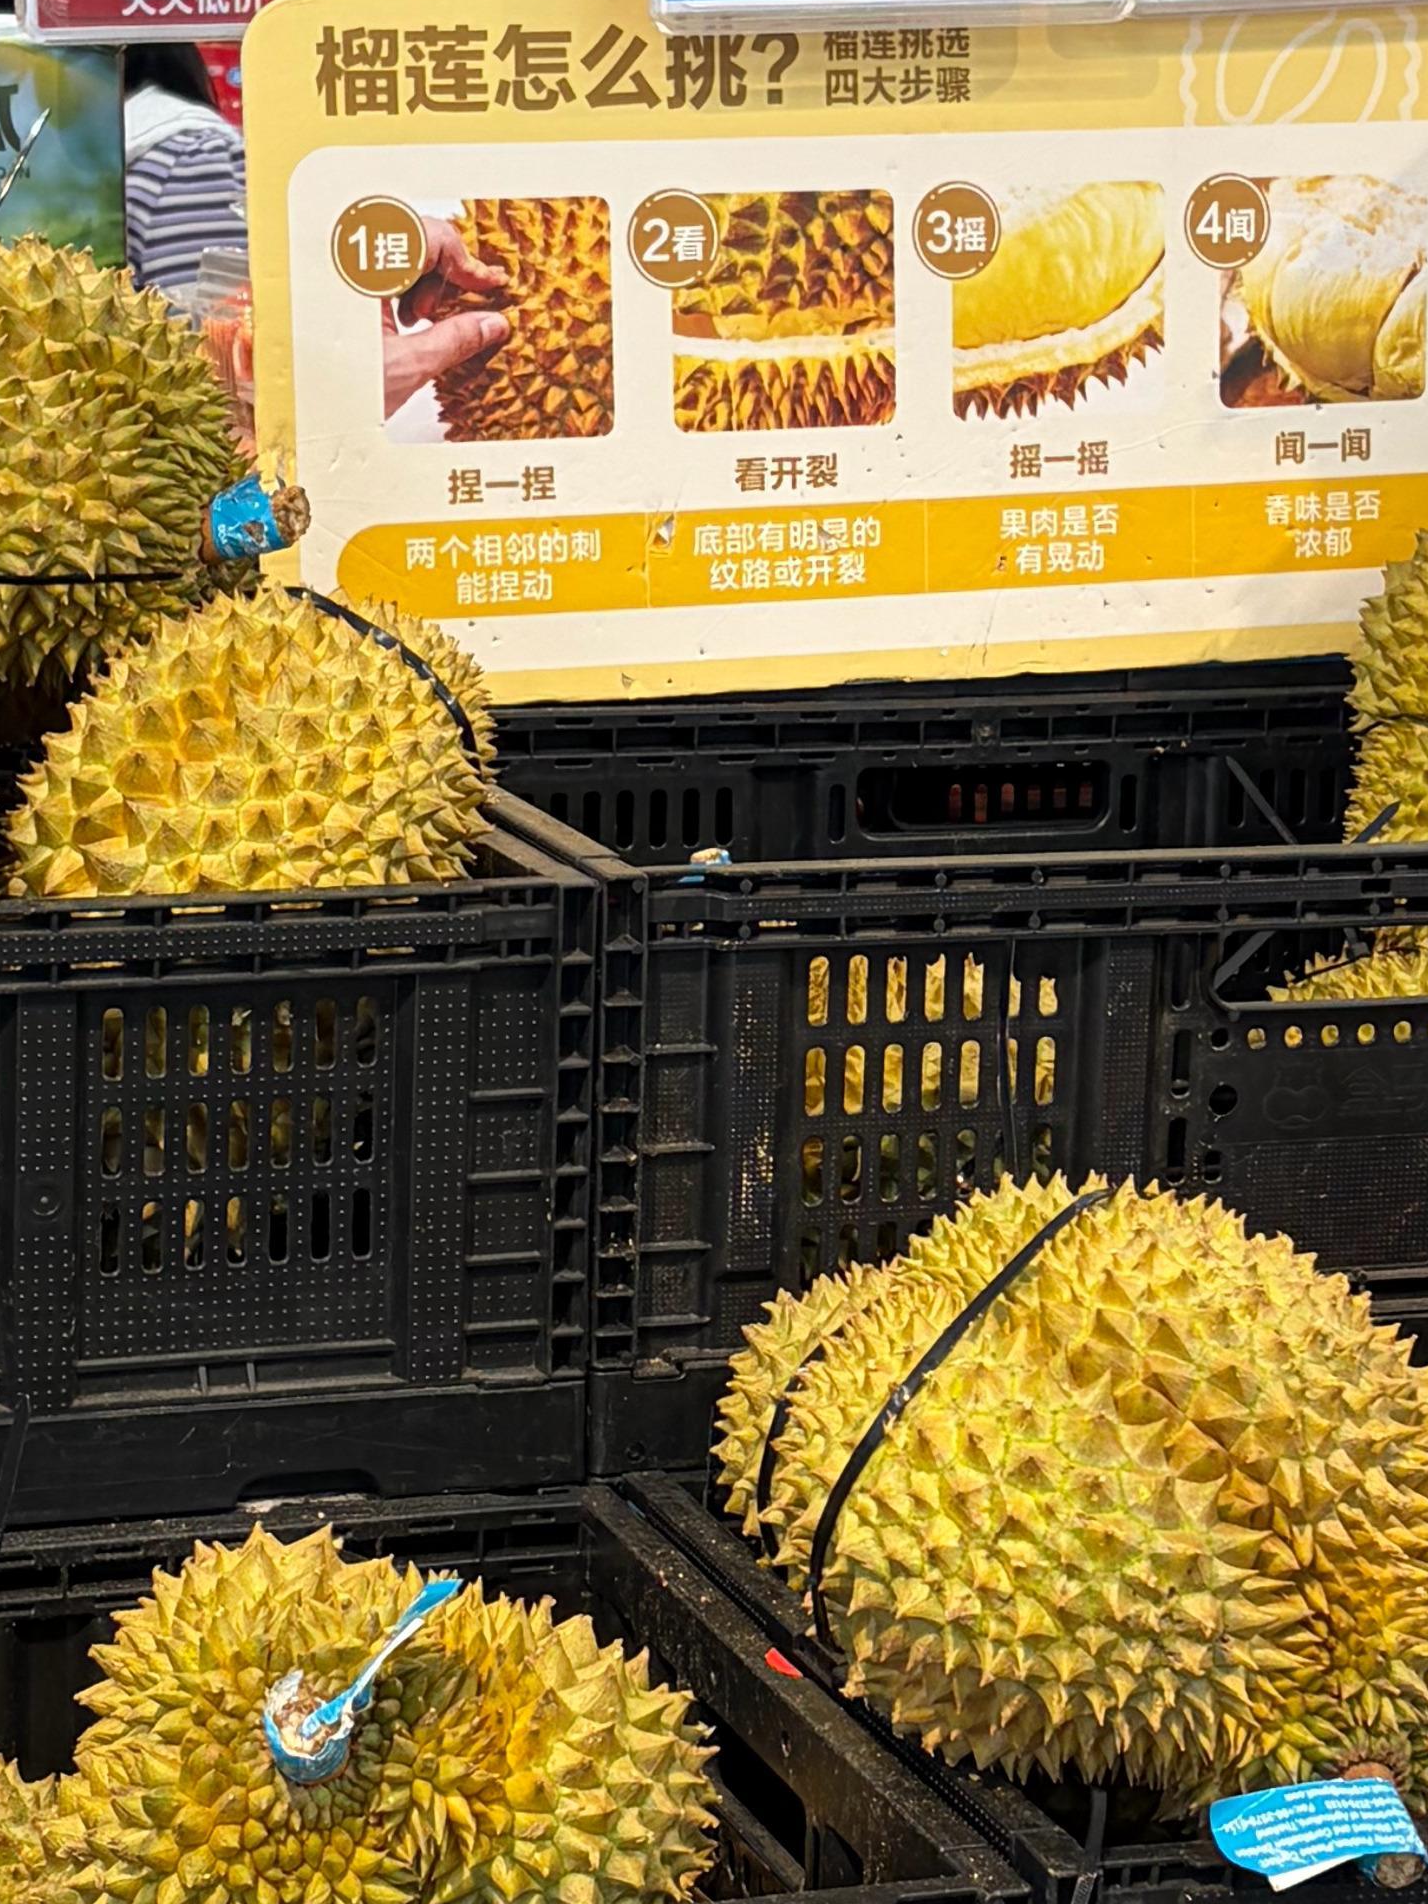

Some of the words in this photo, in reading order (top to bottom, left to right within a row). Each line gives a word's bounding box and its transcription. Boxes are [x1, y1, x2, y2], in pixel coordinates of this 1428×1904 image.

[315, 22, 801, 116] 榴莲怎么挑?
[824, 65, 972, 106] 四大步骤
[641, 217, 707, 263] 2看
[1009, 441, 1110, 479] 摇一摇
[1274, 428, 1372, 465] 闻一闻
[447, 466, 557, 505] 捏一捏
[734, 453, 839, 491] 看开裂
[1000, 503, 1120, 539] 果肉是否
[1263, 489, 1382, 526] 香味是否
[405, 528, 602, 570] 两个相邻的刺
[693, 516, 882, 556] 底部有明显的
[1294, 526, 1353, 559] 浓郁
[709, 552, 867, 591] 纹路或开裂
[1015, 539, 1106, 574] 有晃动
[456, 568, 553, 605] 能捏动
